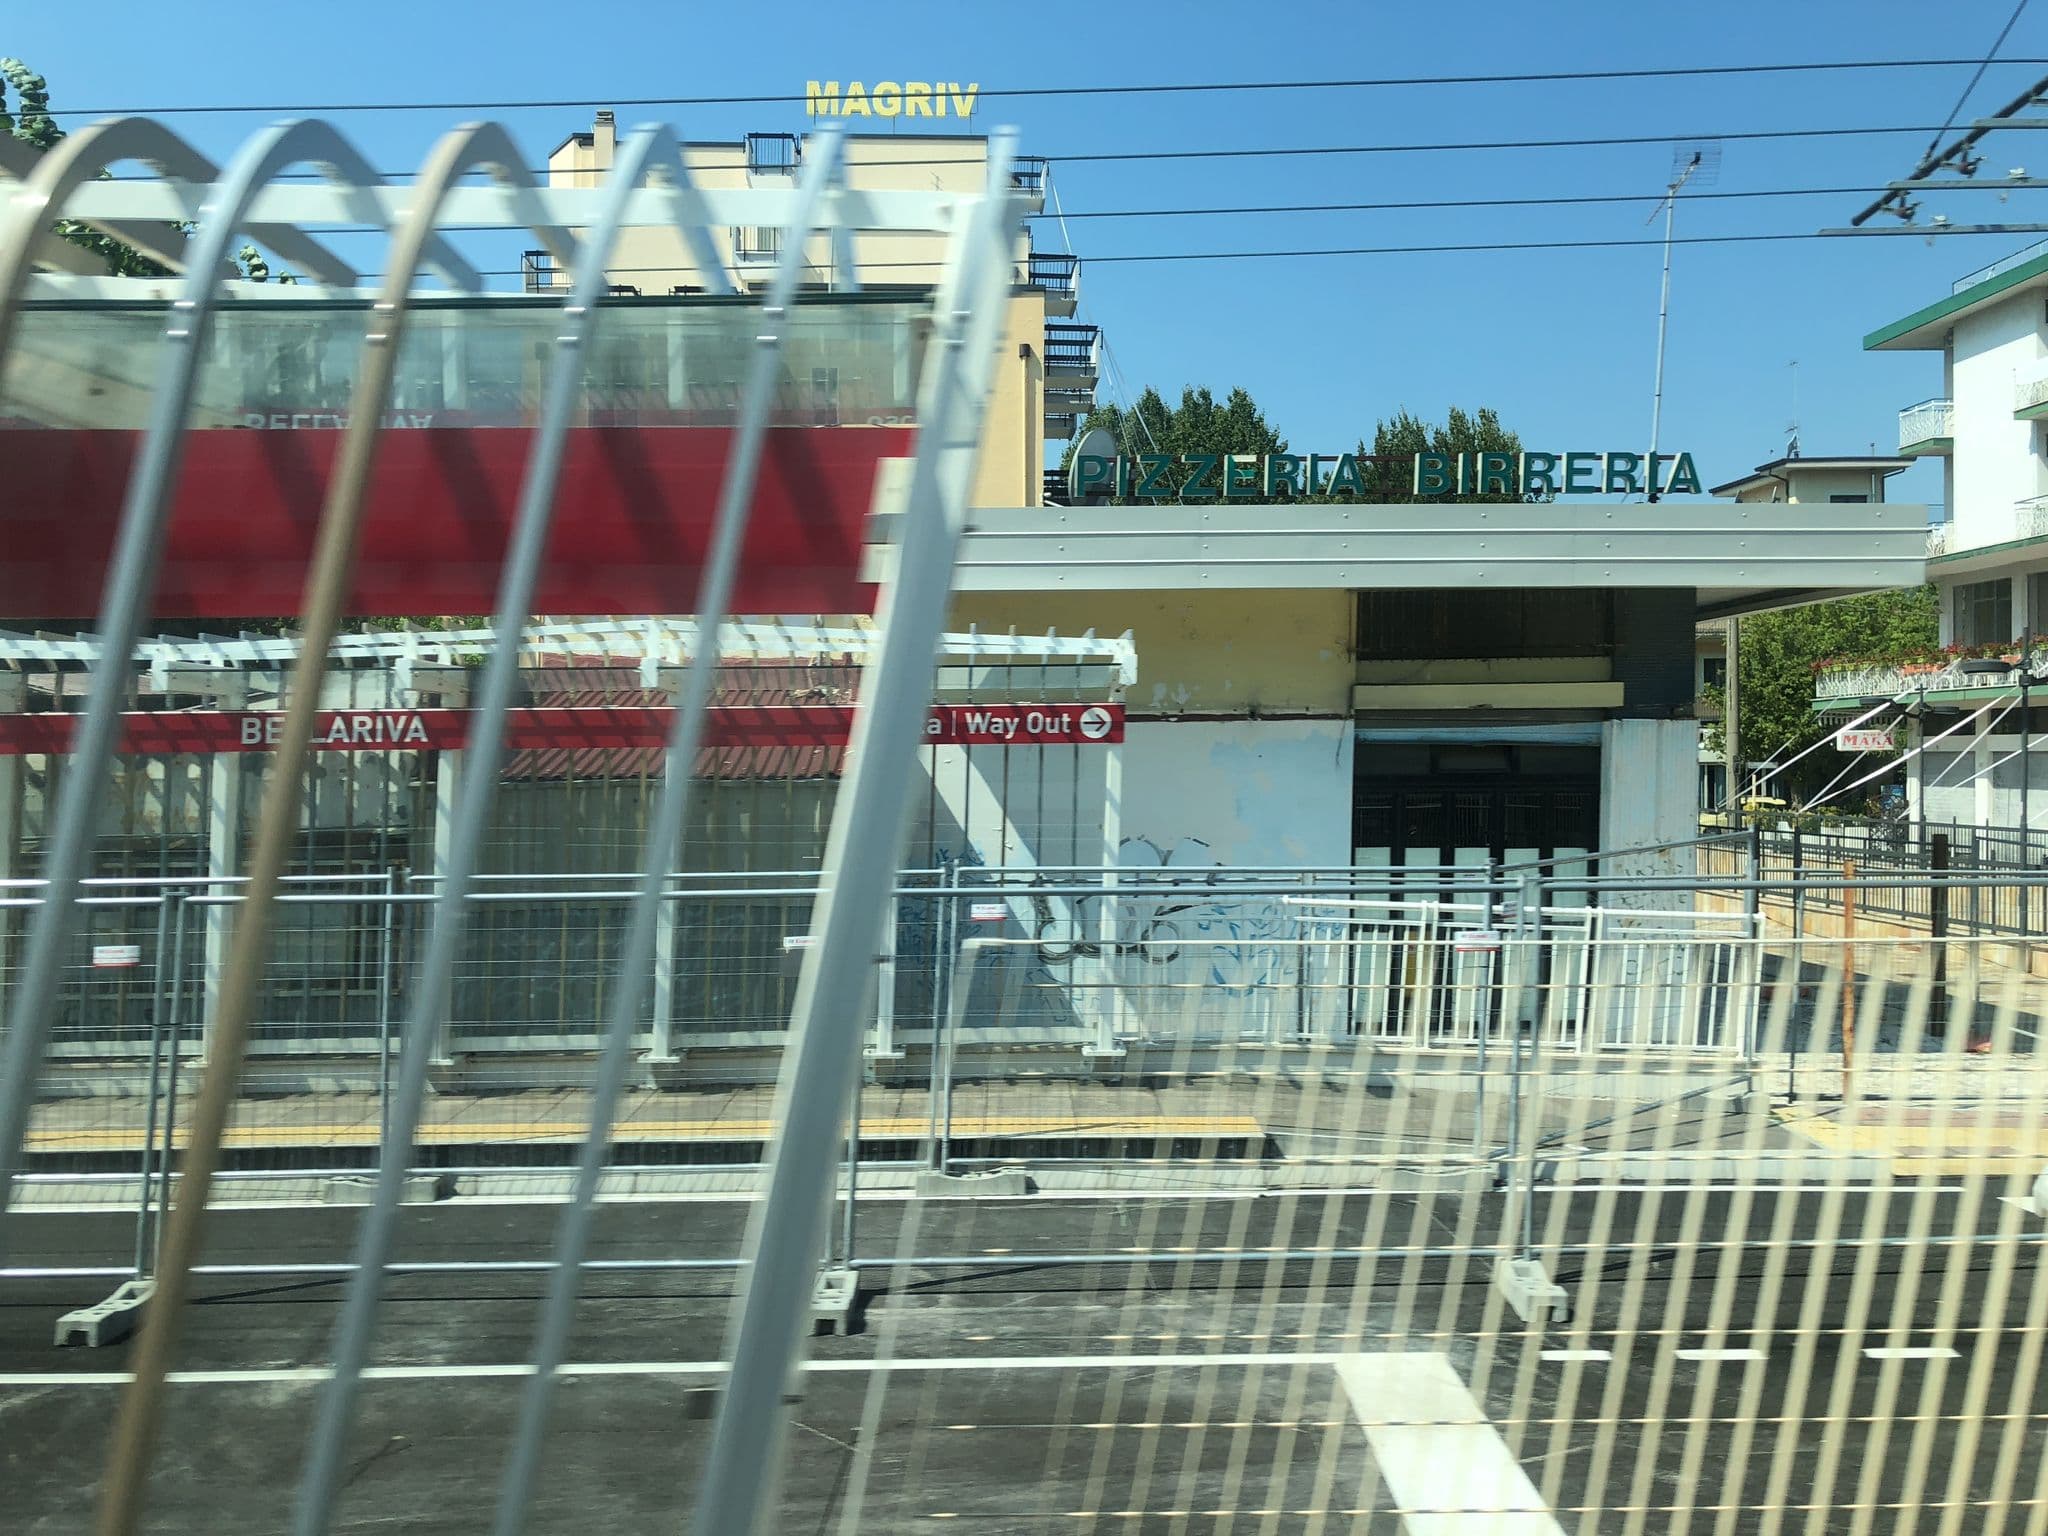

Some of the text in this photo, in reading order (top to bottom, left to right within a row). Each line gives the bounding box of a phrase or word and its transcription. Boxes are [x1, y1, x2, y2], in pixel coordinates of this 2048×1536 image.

[806, 80, 979, 117] MAGRIV
[1074, 451, 1702, 497] PIZZERIA BIRRERIA
[241, 715, 429, 744] BELARIVA
[964, 712, 1019, 739] Way
[1026, 711, 1070, 734] Out
